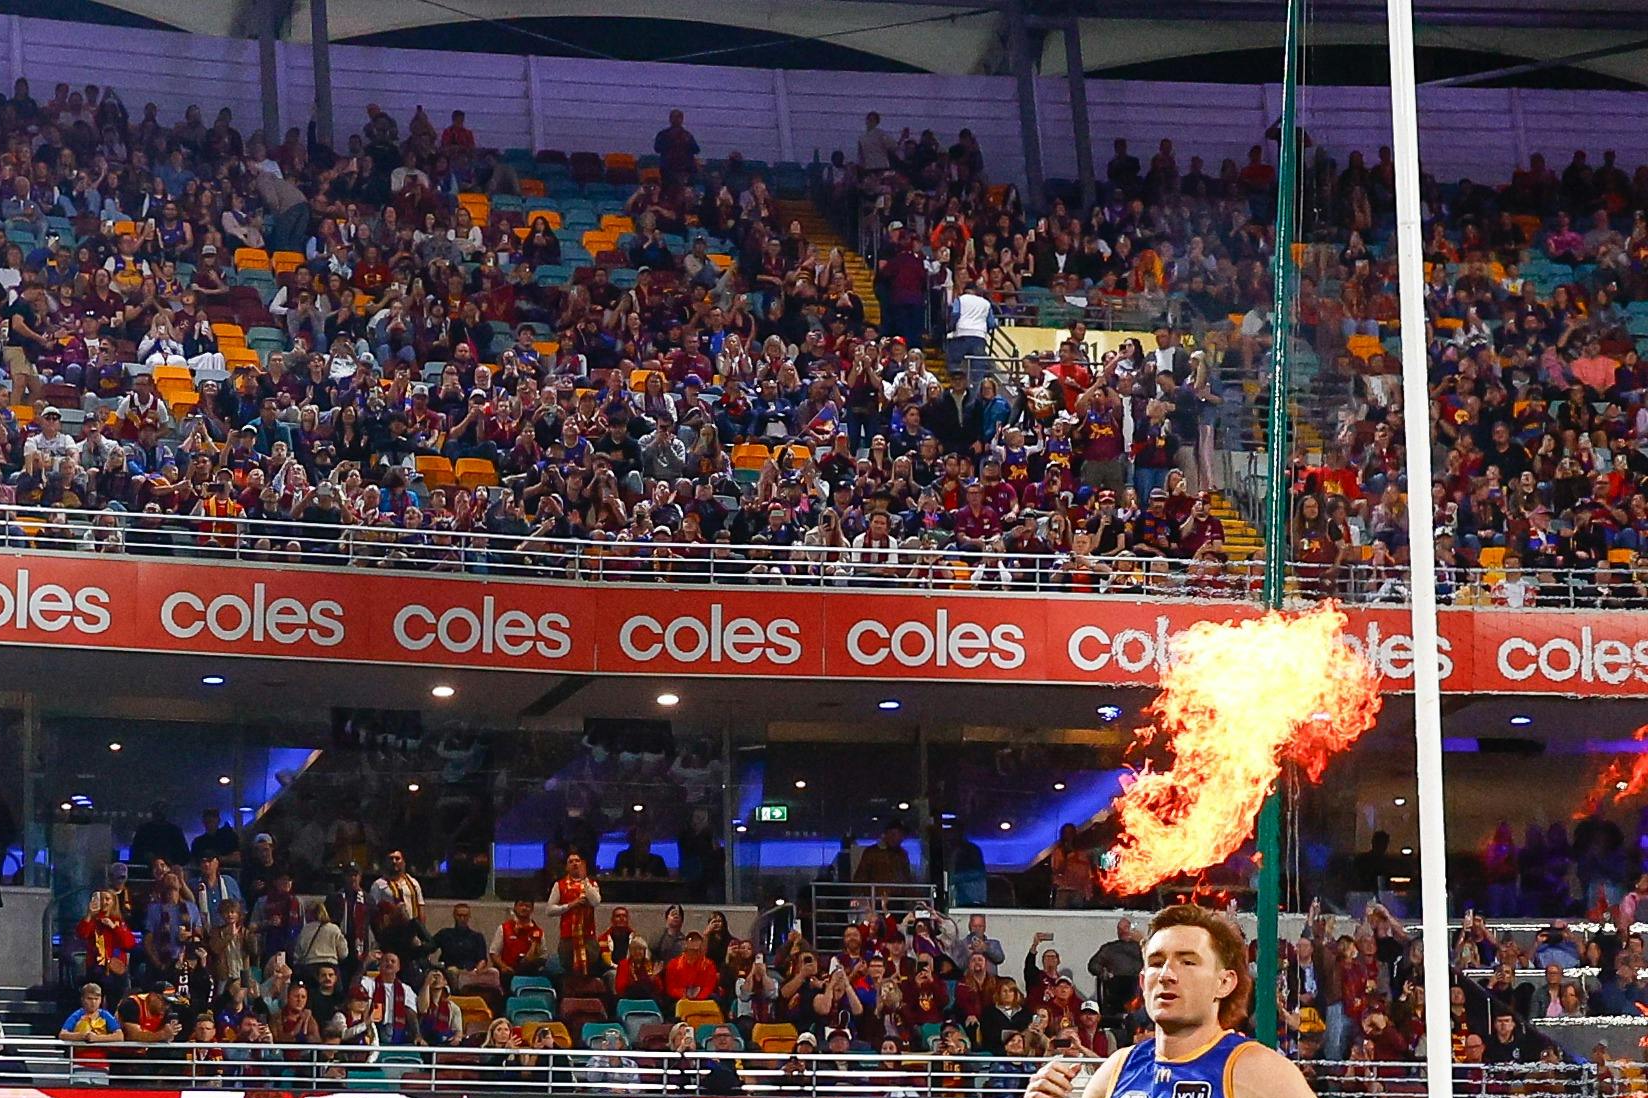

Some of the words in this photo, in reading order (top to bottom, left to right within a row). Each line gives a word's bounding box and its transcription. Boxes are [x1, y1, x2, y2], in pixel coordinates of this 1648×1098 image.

[161, 584, 344, 646] coles
[394, 597, 571, 658] coles
[620, 605, 801, 664] coles
[847, 609, 1026, 669] coles
